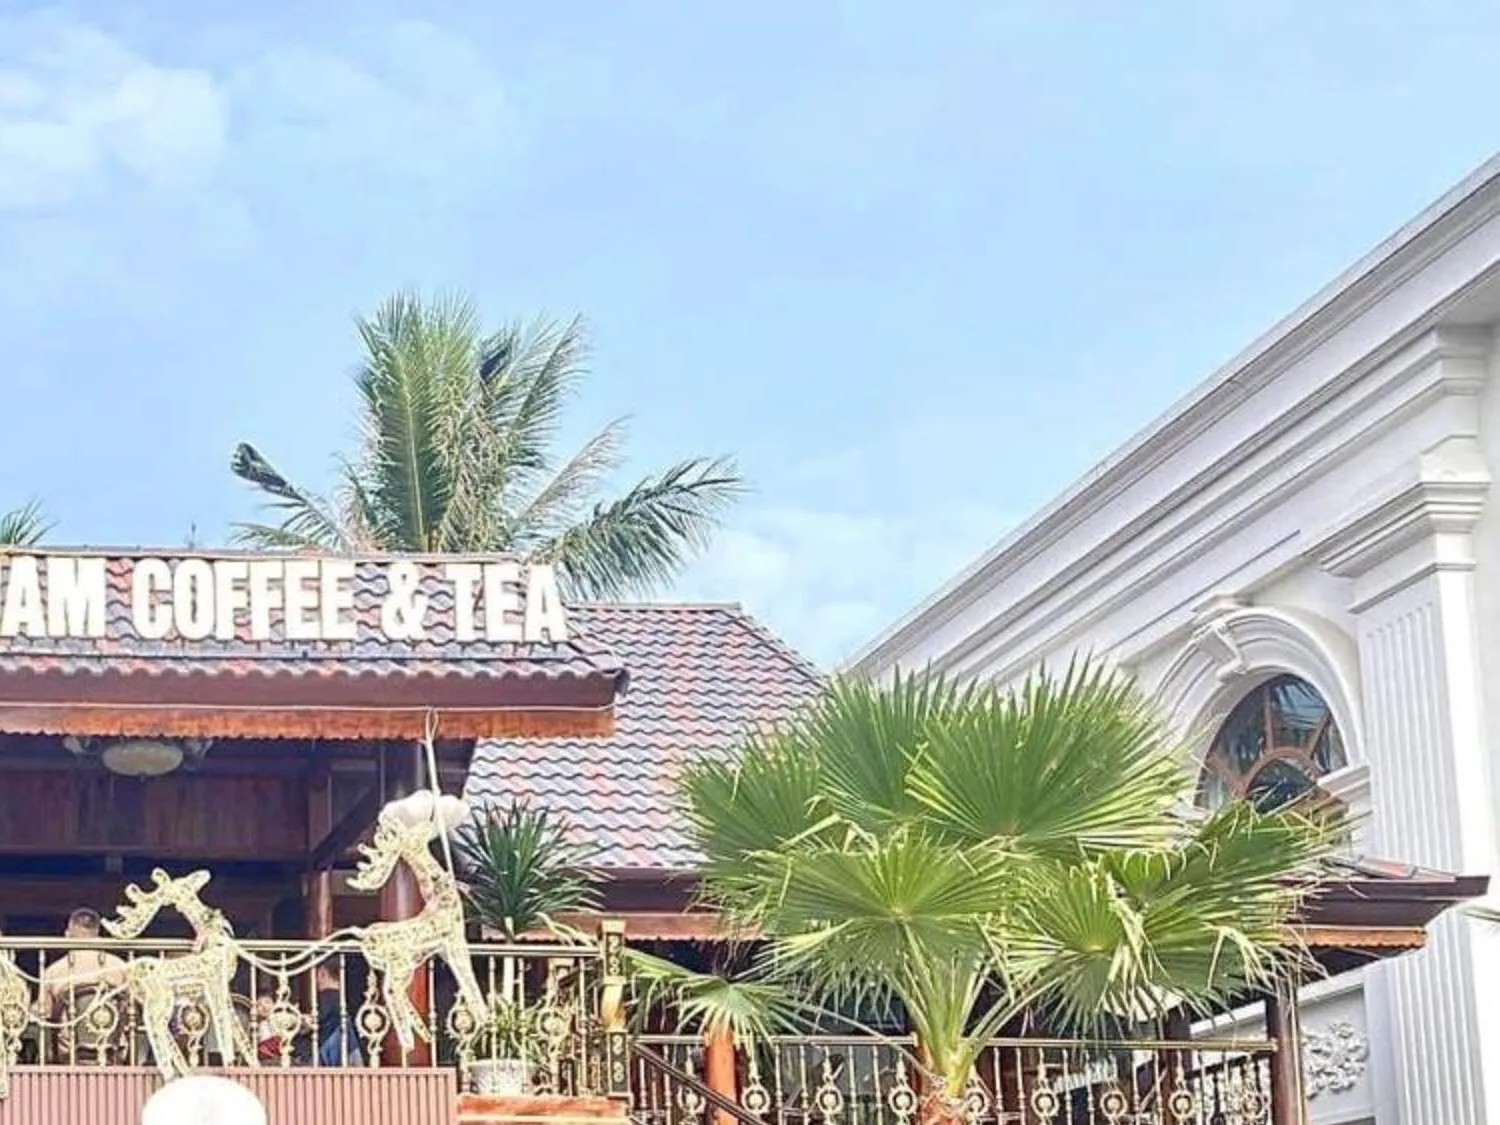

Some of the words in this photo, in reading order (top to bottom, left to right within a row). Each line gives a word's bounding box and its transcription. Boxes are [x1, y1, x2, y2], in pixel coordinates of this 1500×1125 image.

[132, 558, 356, 641] COFFEE
[380, 560, 430, 641] &
[444, 561, 568, 643] TEA
